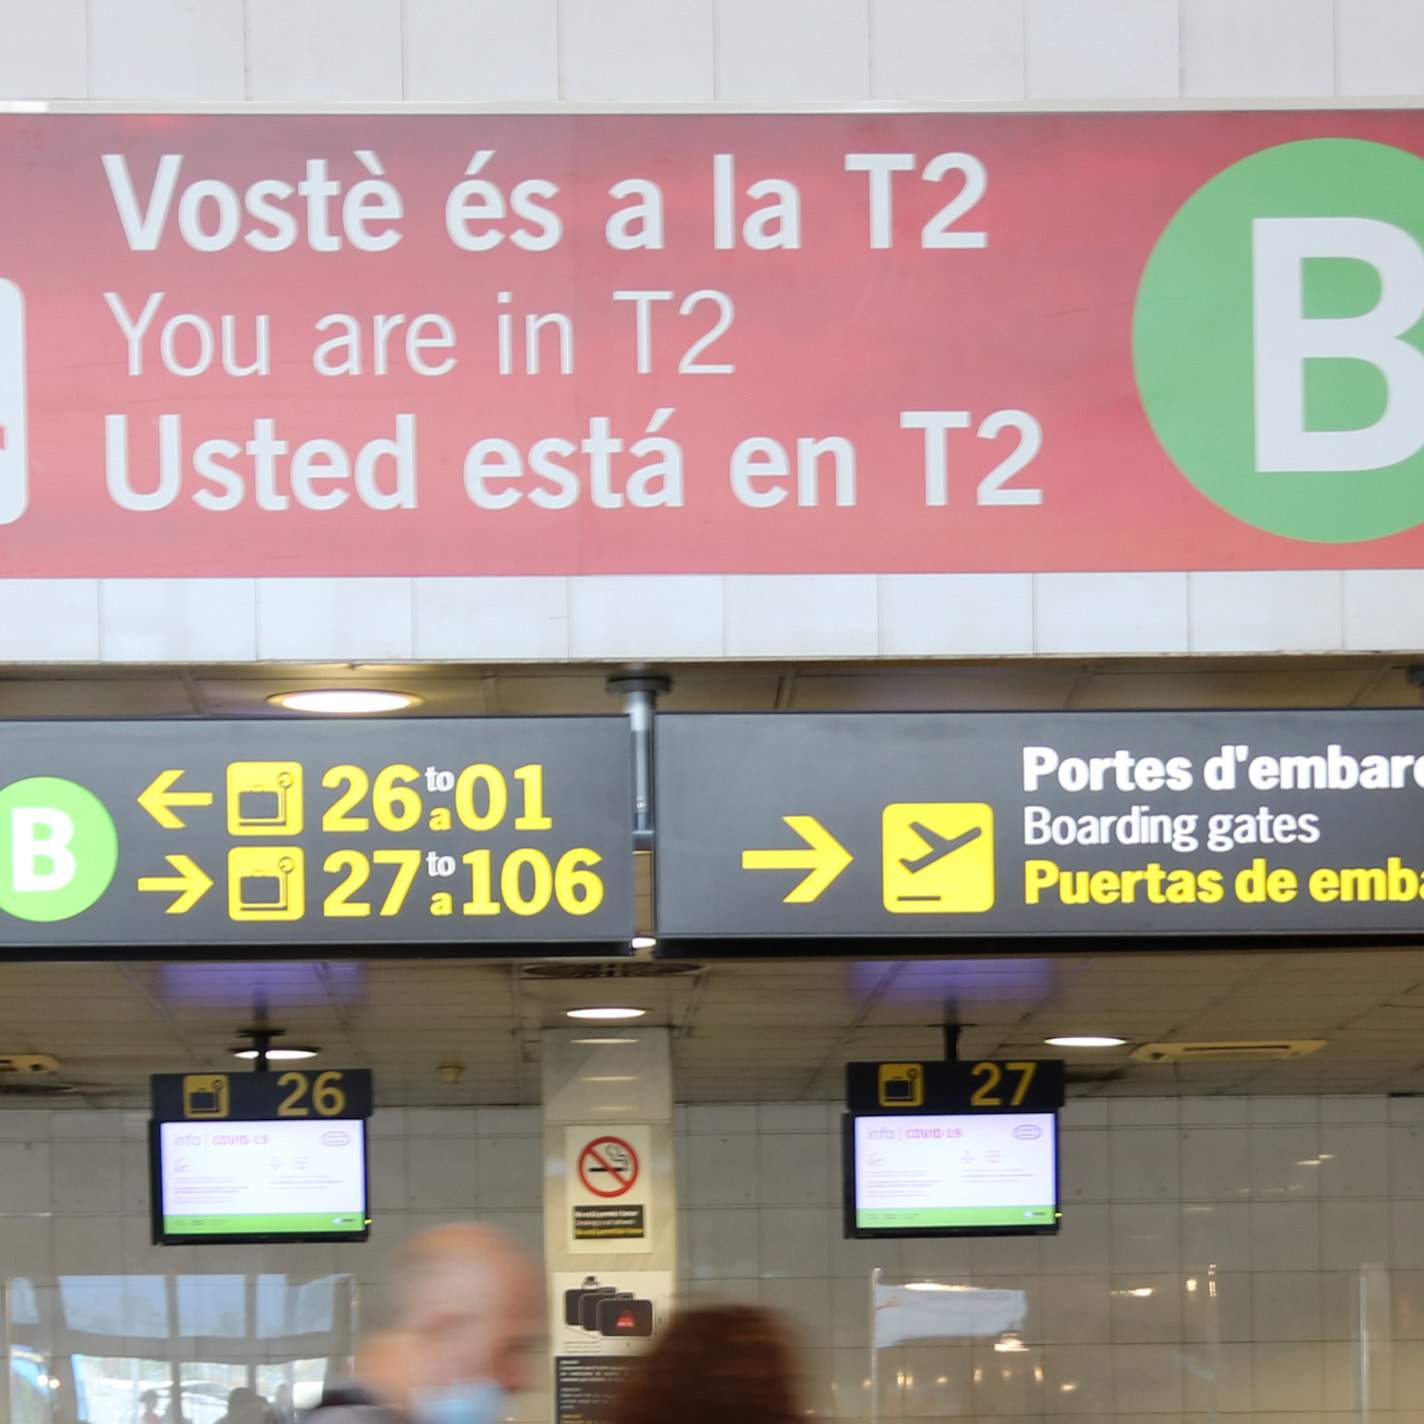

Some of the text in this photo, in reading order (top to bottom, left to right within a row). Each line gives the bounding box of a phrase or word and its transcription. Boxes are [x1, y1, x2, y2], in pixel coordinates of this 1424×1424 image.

[101, 149, 988, 254] Vostè és a la T2
[103, 289, 735, 378] You are in T2
[104, 407, 1043, 513] Usted está en T2
[321, 763, 422, 833] 26
[455, 763, 552, 832] 01
[1022, 746, 1194, 793] Portes
[10, 807, 77, 893] B
[1023, 804, 1321, 855] Boarding gates
[322, 848, 422, 917] 27
[462, 847, 605, 917] 106
[1024, 859, 1224, 906] Puertas
[1234, 858, 1298, 904] de
[277, 1071, 346, 1117] 26
[970, 1061, 1038, 1106] 27
